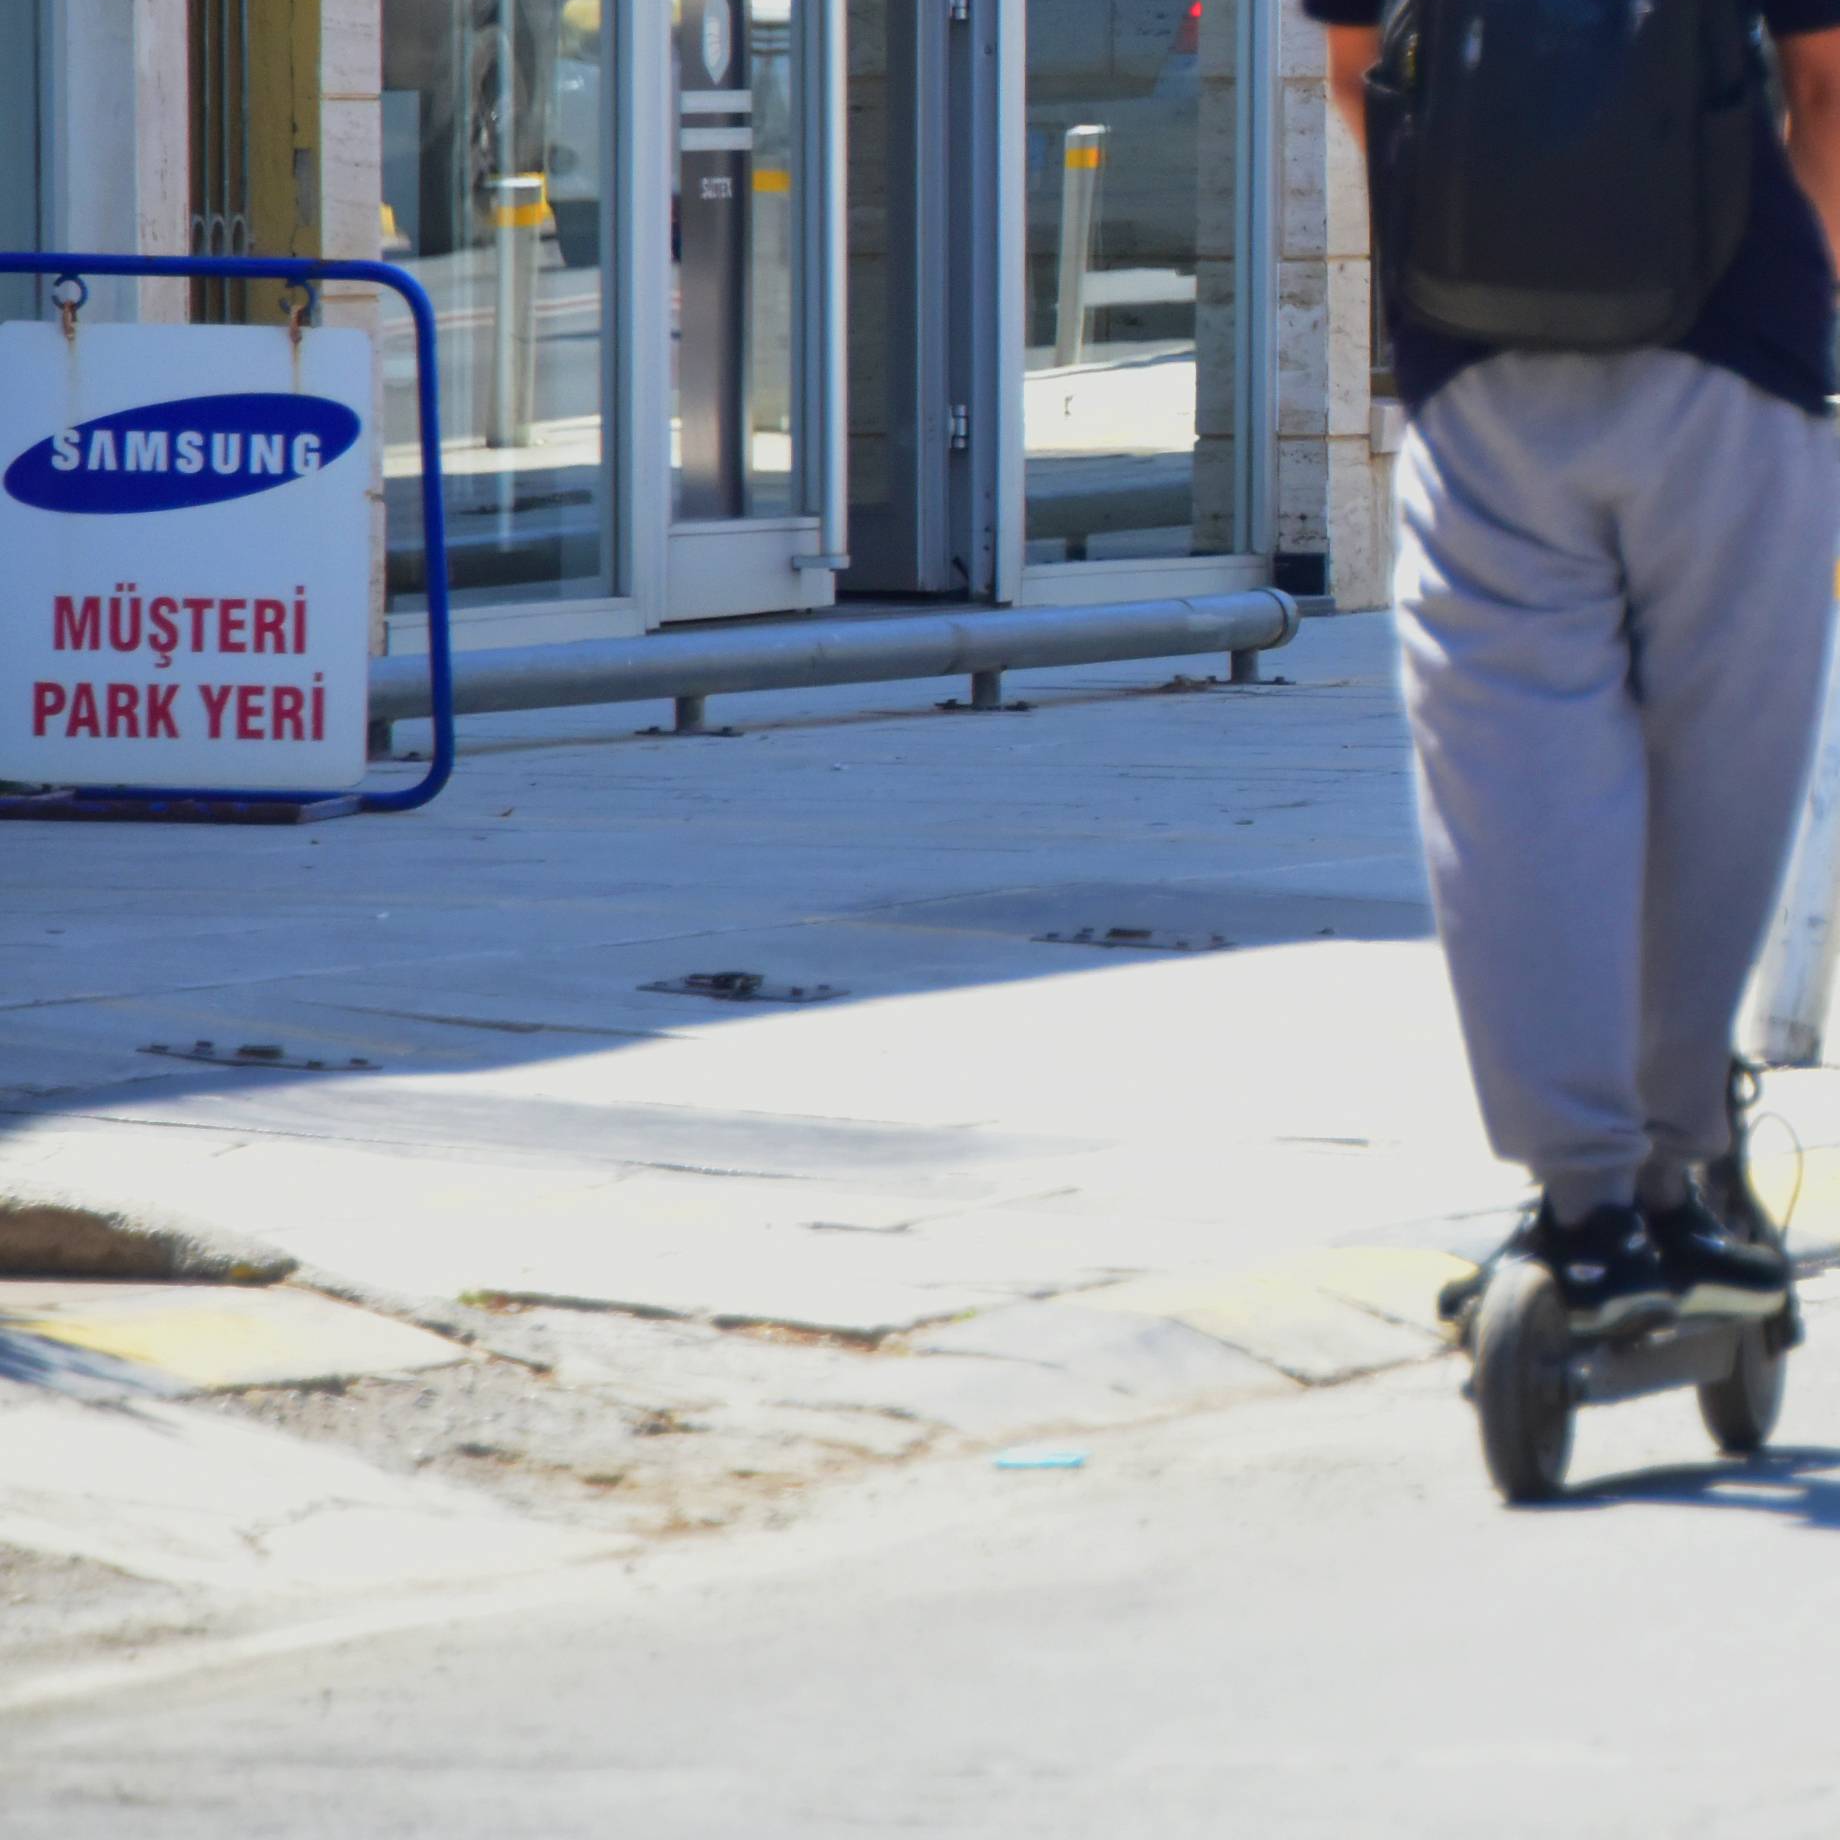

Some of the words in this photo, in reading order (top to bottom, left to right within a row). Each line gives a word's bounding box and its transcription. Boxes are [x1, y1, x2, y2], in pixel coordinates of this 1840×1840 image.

[51, 428, 322, 477] SAMSUNG
[53, 582, 309, 669] MÜŞTERİ
[31, 681, 181, 740] PARK
[199, 671, 326, 742] YERİ
